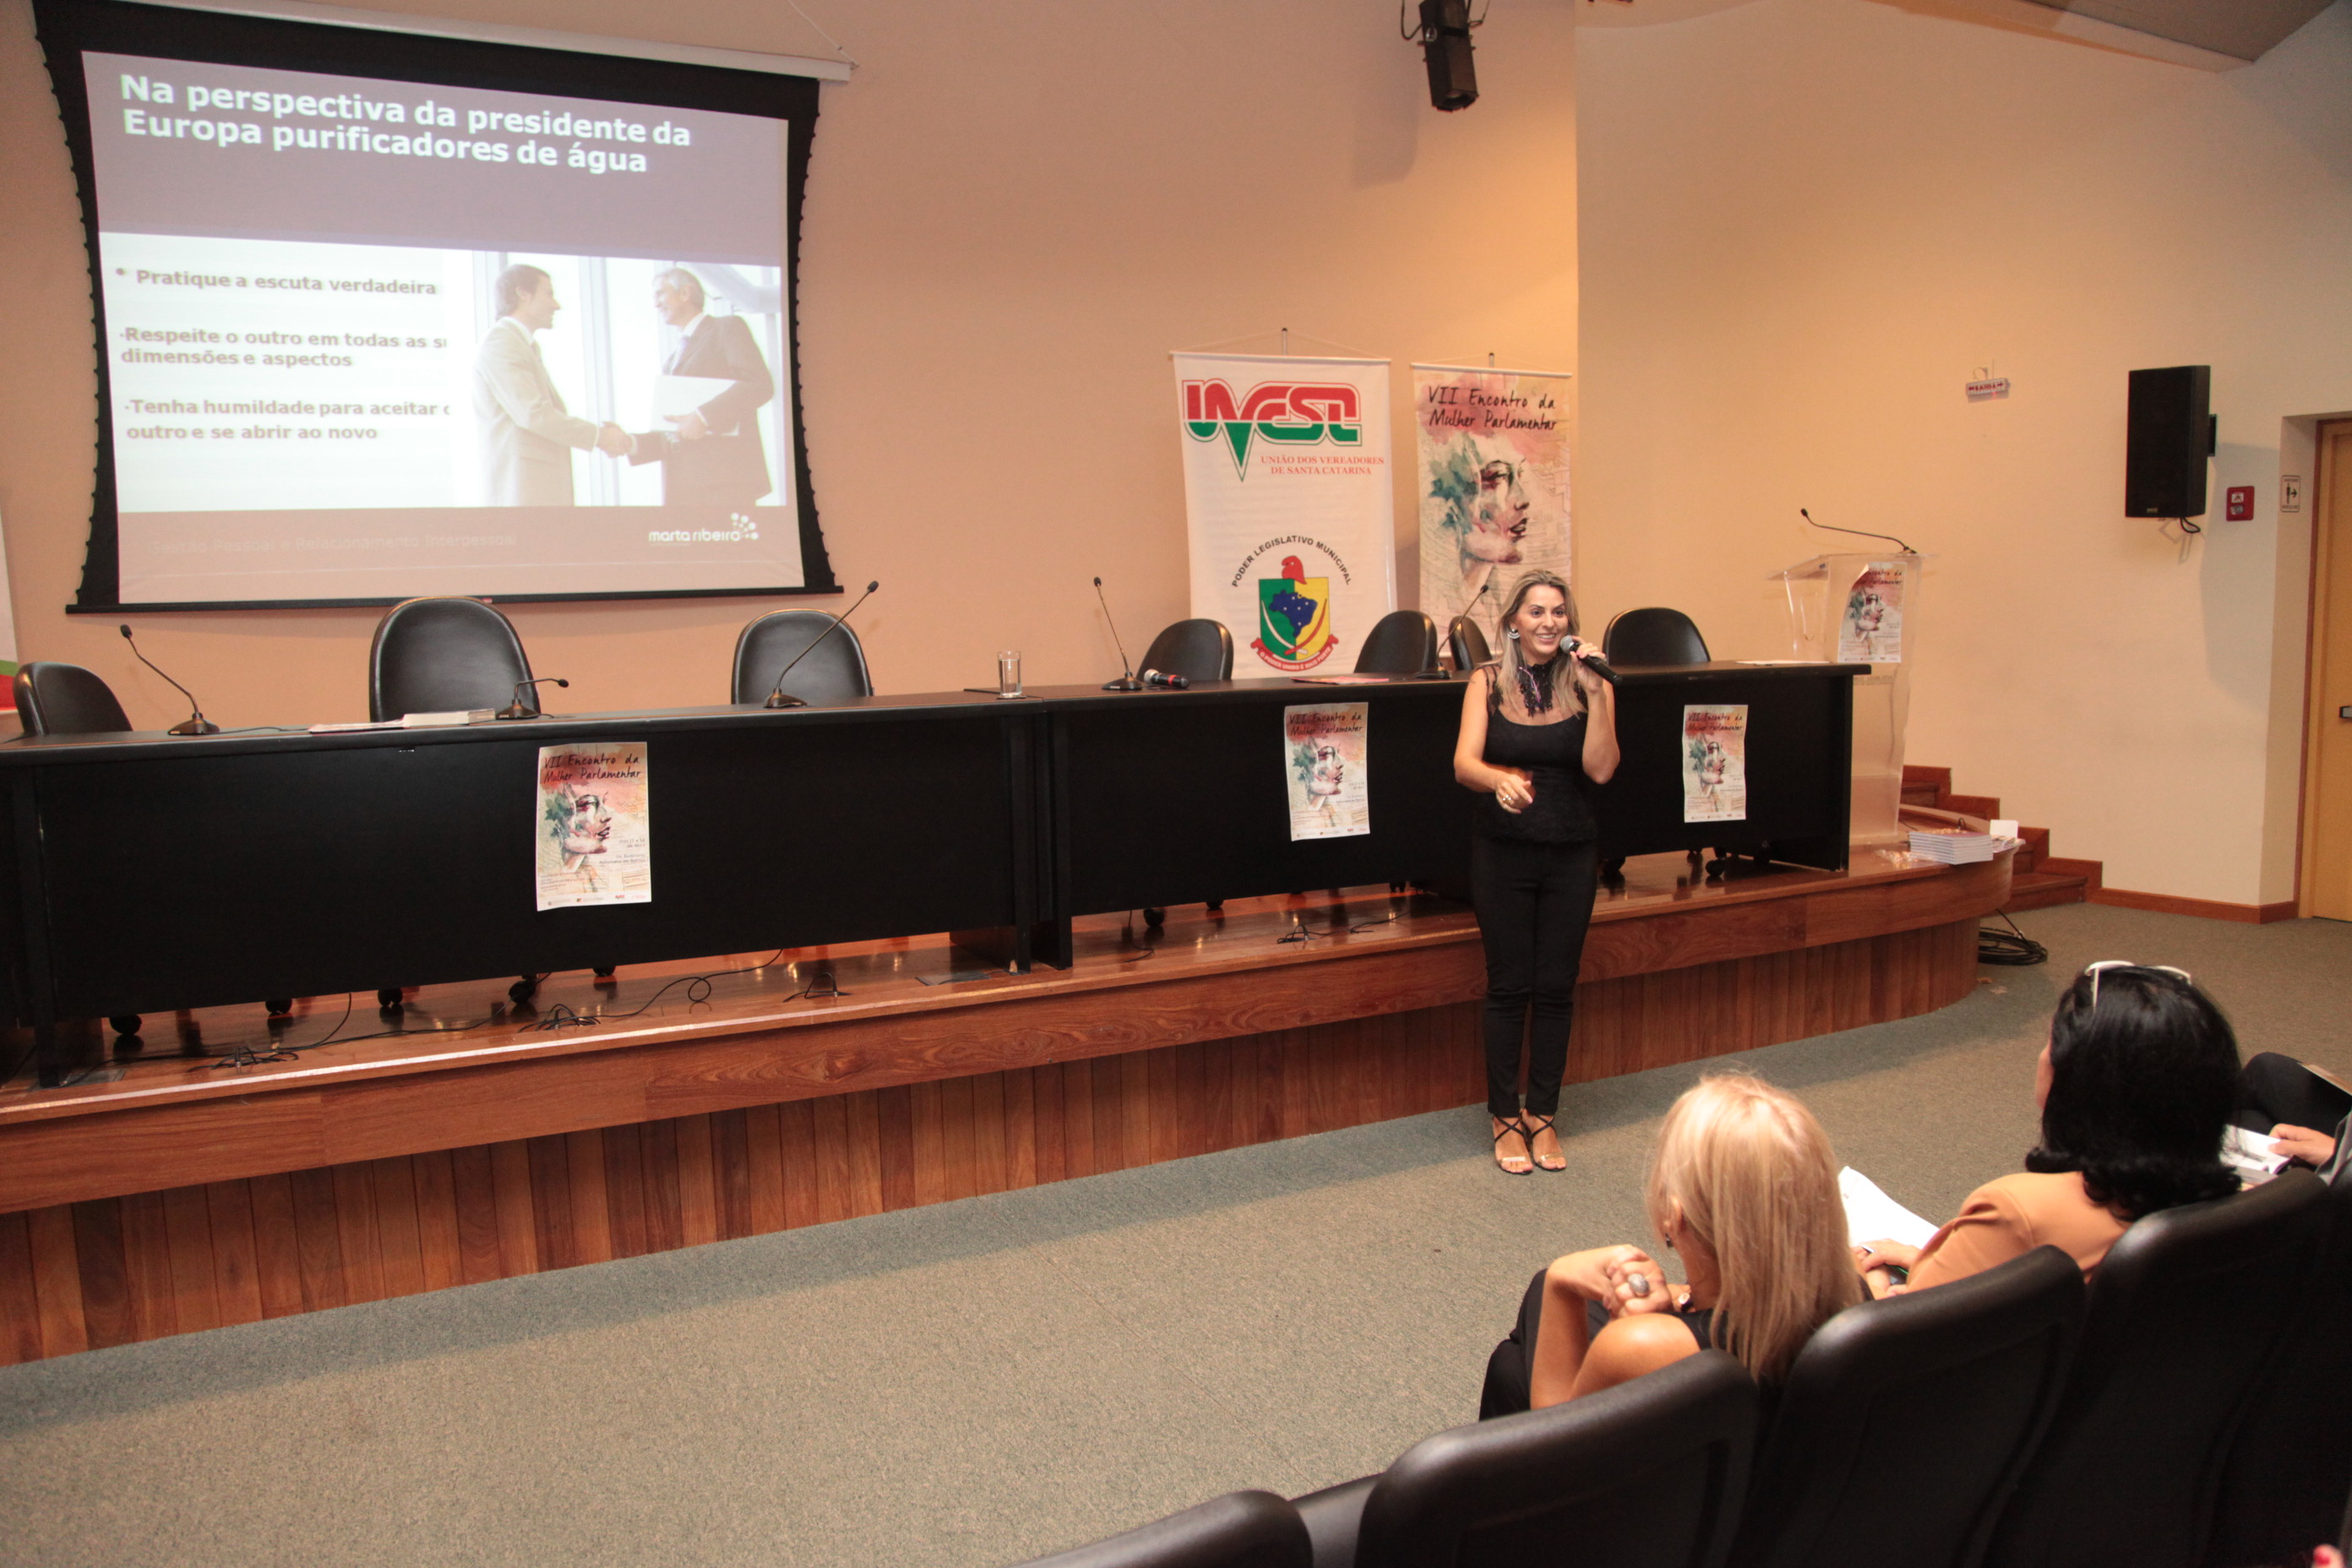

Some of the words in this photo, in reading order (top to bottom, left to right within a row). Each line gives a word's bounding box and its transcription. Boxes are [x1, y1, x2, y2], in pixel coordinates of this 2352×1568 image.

[120, 74, 173, 104] Na
[187, 84, 405, 123] perspectiva
[414, 100, 455, 127] da
[468, 110, 646, 143] presidente
[652, 121, 690, 146] da
[123, 109, 261, 148] Europa
[273, 124, 509, 162] purificadores
[517, 140, 557, 165] de
[568, 142, 647, 174] água
[136, 270, 231, 289] Pratique
[235, 274, 248, 287] a
[254, 275, 322, 291] escuta
[329, 278, 437, 295] verdadeira
[125, 328, 220, 347] Respeite
[226, 331, 238, 343] o
[244, 331, 302, 346] outro
[308, 334, 338, 346] em
[345, 333, 399, 348] todas
[406, 336, 427, 348] as
[121, 348, 239, 365] dimensões
[243, 353, 255, 365] e
[263, 351, 352, 368] aspectos
[1429, 386, 1459, 405] VII
[1469, 389, 1527, 407] Encontro
[1538, 394, 1554, 409] da
[129, 399, 198, 415] Tenha
[203, 399, 315, 416] humildade
[318, 403, 363, 418] para
[370, 400, 438, 416] aceitar
[1429, 409, 1476, 427] Mulher
[1484, 410, 1557, 430] Parlamentar
[127, 425, 187, 439] outro
[192, 427, 204, 439] e
[210, 427, 235, 439] se
[241, 425, 291, 439] abrir
[297, 427, 322, 439] ao
[328, 427, 378, 439] novo
[1260, 454, 1294, 465] UNIÃO
[1298, 456, 1317, 465] DOS
[1319, 456, 1385, 466] VEREADORES
[1271, 466, 1282, 475] DE
[1287, 466, 1320, 475] SANTA
[1322, 466, 1371, 476] CATARINA
[149, 540, 207, 554] Gestão
[213, 538, 275, 553] Pessoal
[296, 536, 419, 551] Relacionamento
[424, 534, 518, 548] Interpessoal
[649, 530, 690, 542] marta
[693, 528, 740, 542] ribeiro
[1232, 555, 1255, 587] PODER
[1254, 535, 1314, 556] LEGISLATIVO
[1316, 542, 1352, 585] MUNICIPAL
[1289, 714, 1306, 724] VII
[1312, 712, 1346, 722] Encontro
[1352, 711, 1362, 721] da
[1291, 726, 1316, 736] Mulher
[1320, 723, 1363, 734] Parlamentar
[544, 755, 562, 769] VII
[568, 754, 616, 766] Encontro
[625, 754, 640, 764] da
[544, 770, 573, 783] Mulher
[580, 767, 641, 779] Parlamentar
